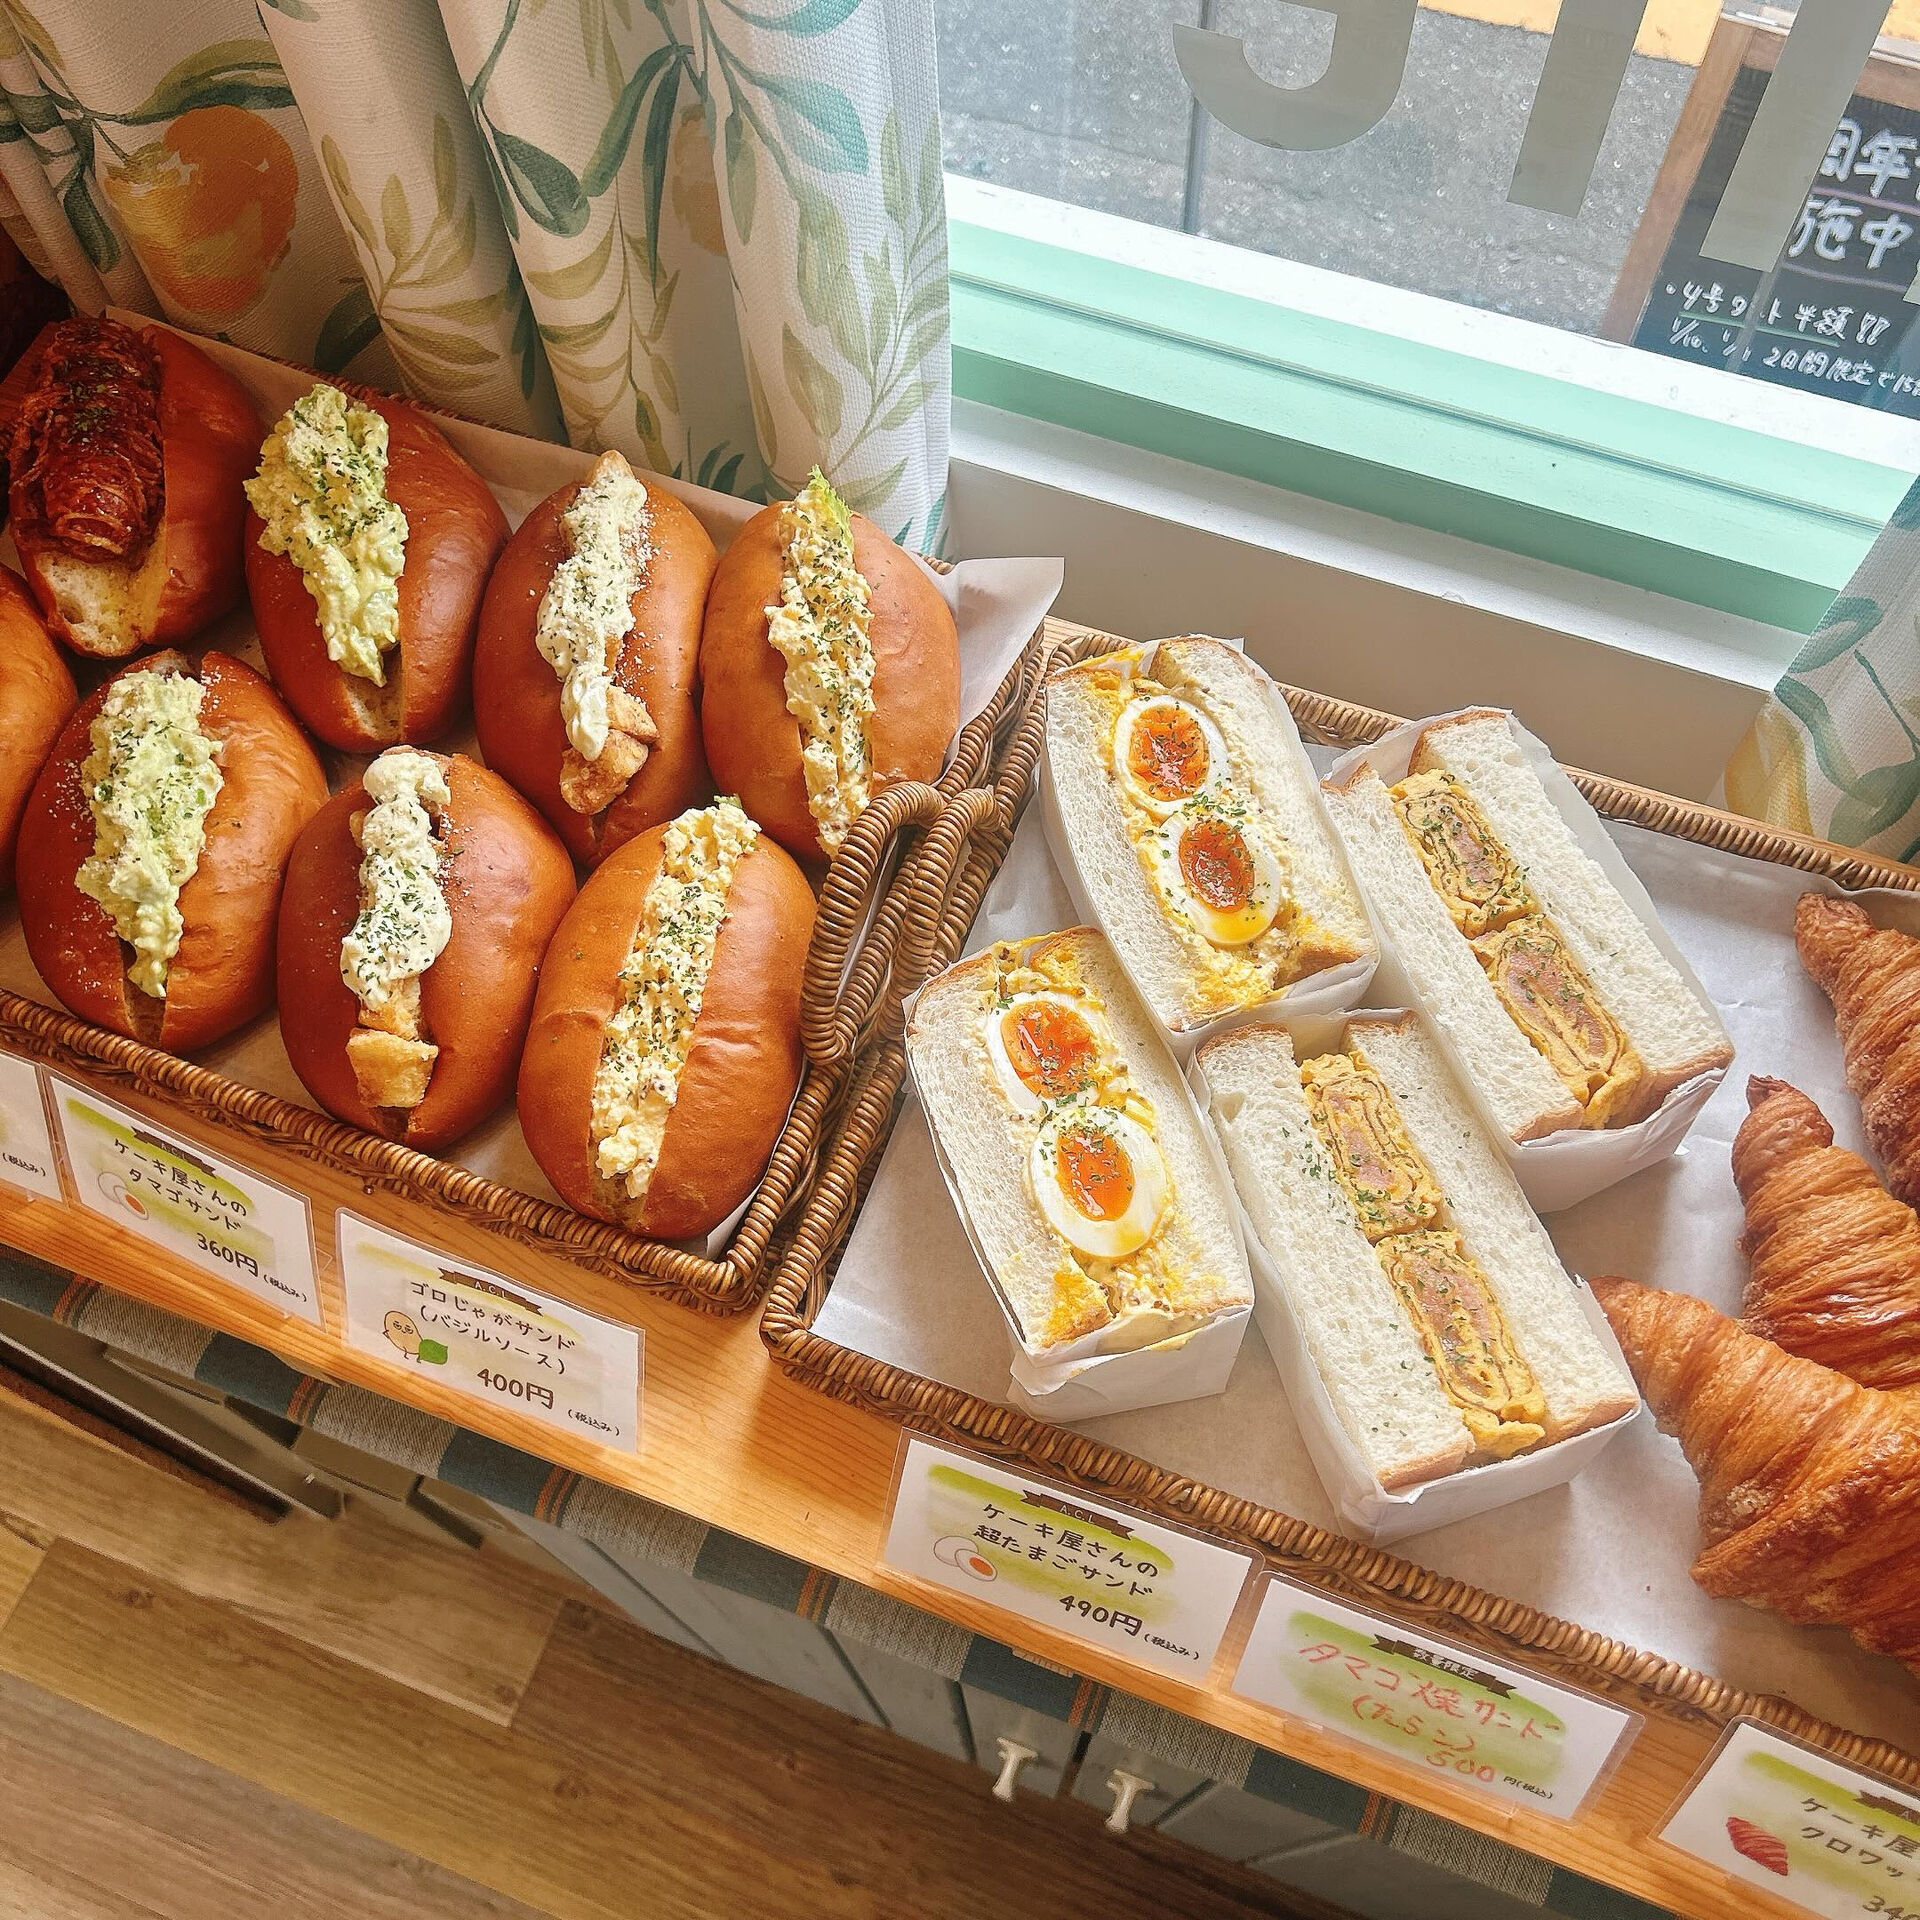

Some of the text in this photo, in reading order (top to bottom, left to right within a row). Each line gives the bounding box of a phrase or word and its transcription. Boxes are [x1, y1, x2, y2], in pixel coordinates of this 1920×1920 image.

[114, 1138, 247, 1217] ケーキ屋さんの
[129, 1168, 241, 1231] タマゴサンド
[196, 1232, 259, 1277] 360円
[410, 1281, 576, 1350] ゴロじゃがサンド
[420, 1305, 566, 1374] (バジルソース)
[477, 1368, 554, 1409] 400円
[973, 1524, 1153, 1596] 超たまごサンド
[983, 1503, 1159, 1577] ケーキ屋さんの
[1059, 1595, 1143, 1636] 490円
[1800, 1798, 1920, 1859] ケーキ屋
[1801, 1827, 1920, 1881] クロワッ
